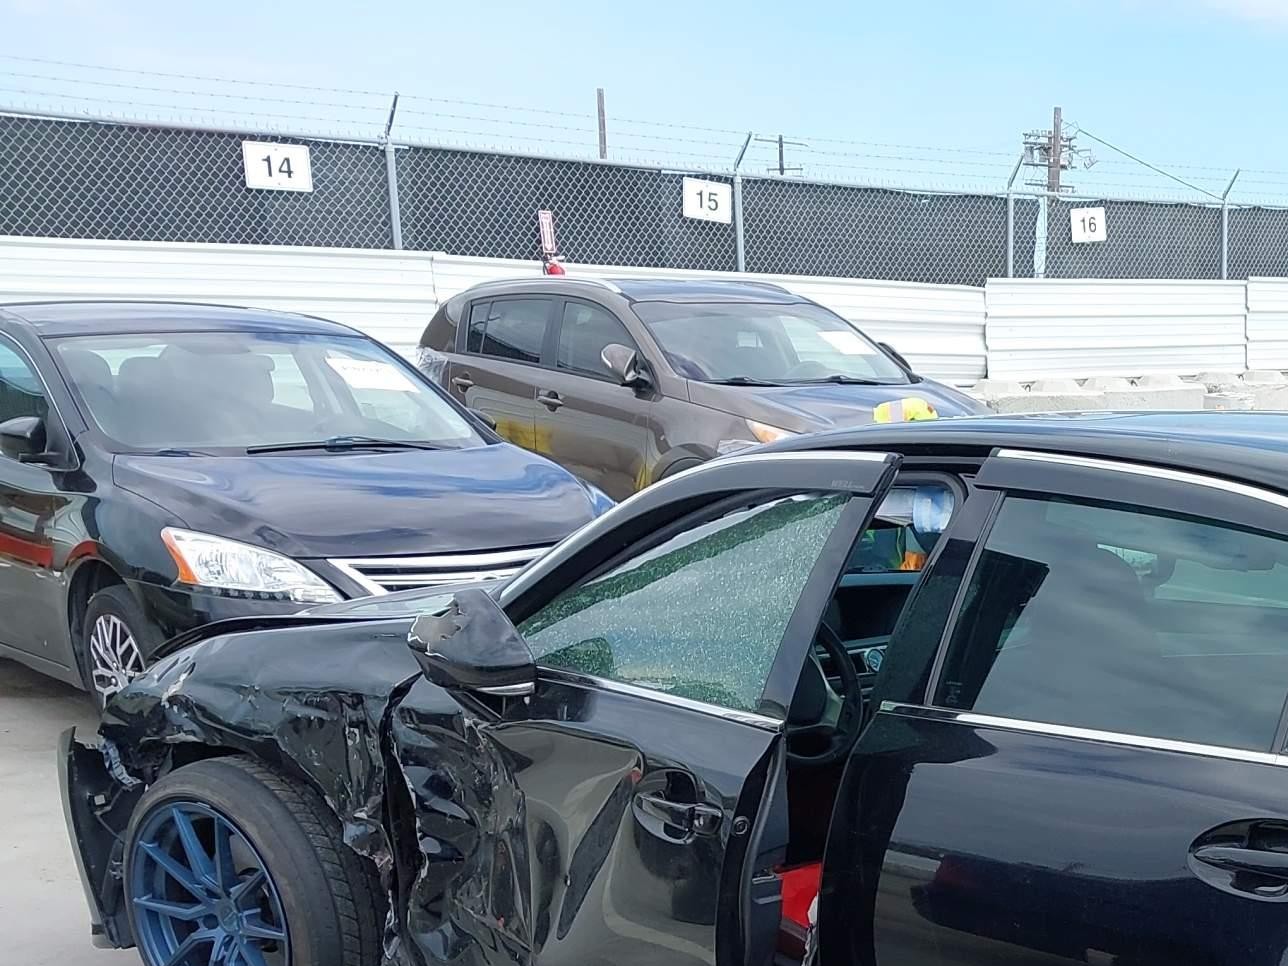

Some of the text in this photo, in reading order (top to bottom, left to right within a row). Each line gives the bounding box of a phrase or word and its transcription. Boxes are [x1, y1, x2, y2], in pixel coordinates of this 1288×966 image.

[261, 155, 294, 179] 14
[696, 190, 719, 212] 15
[1079, 216, 1097, 233] 16
